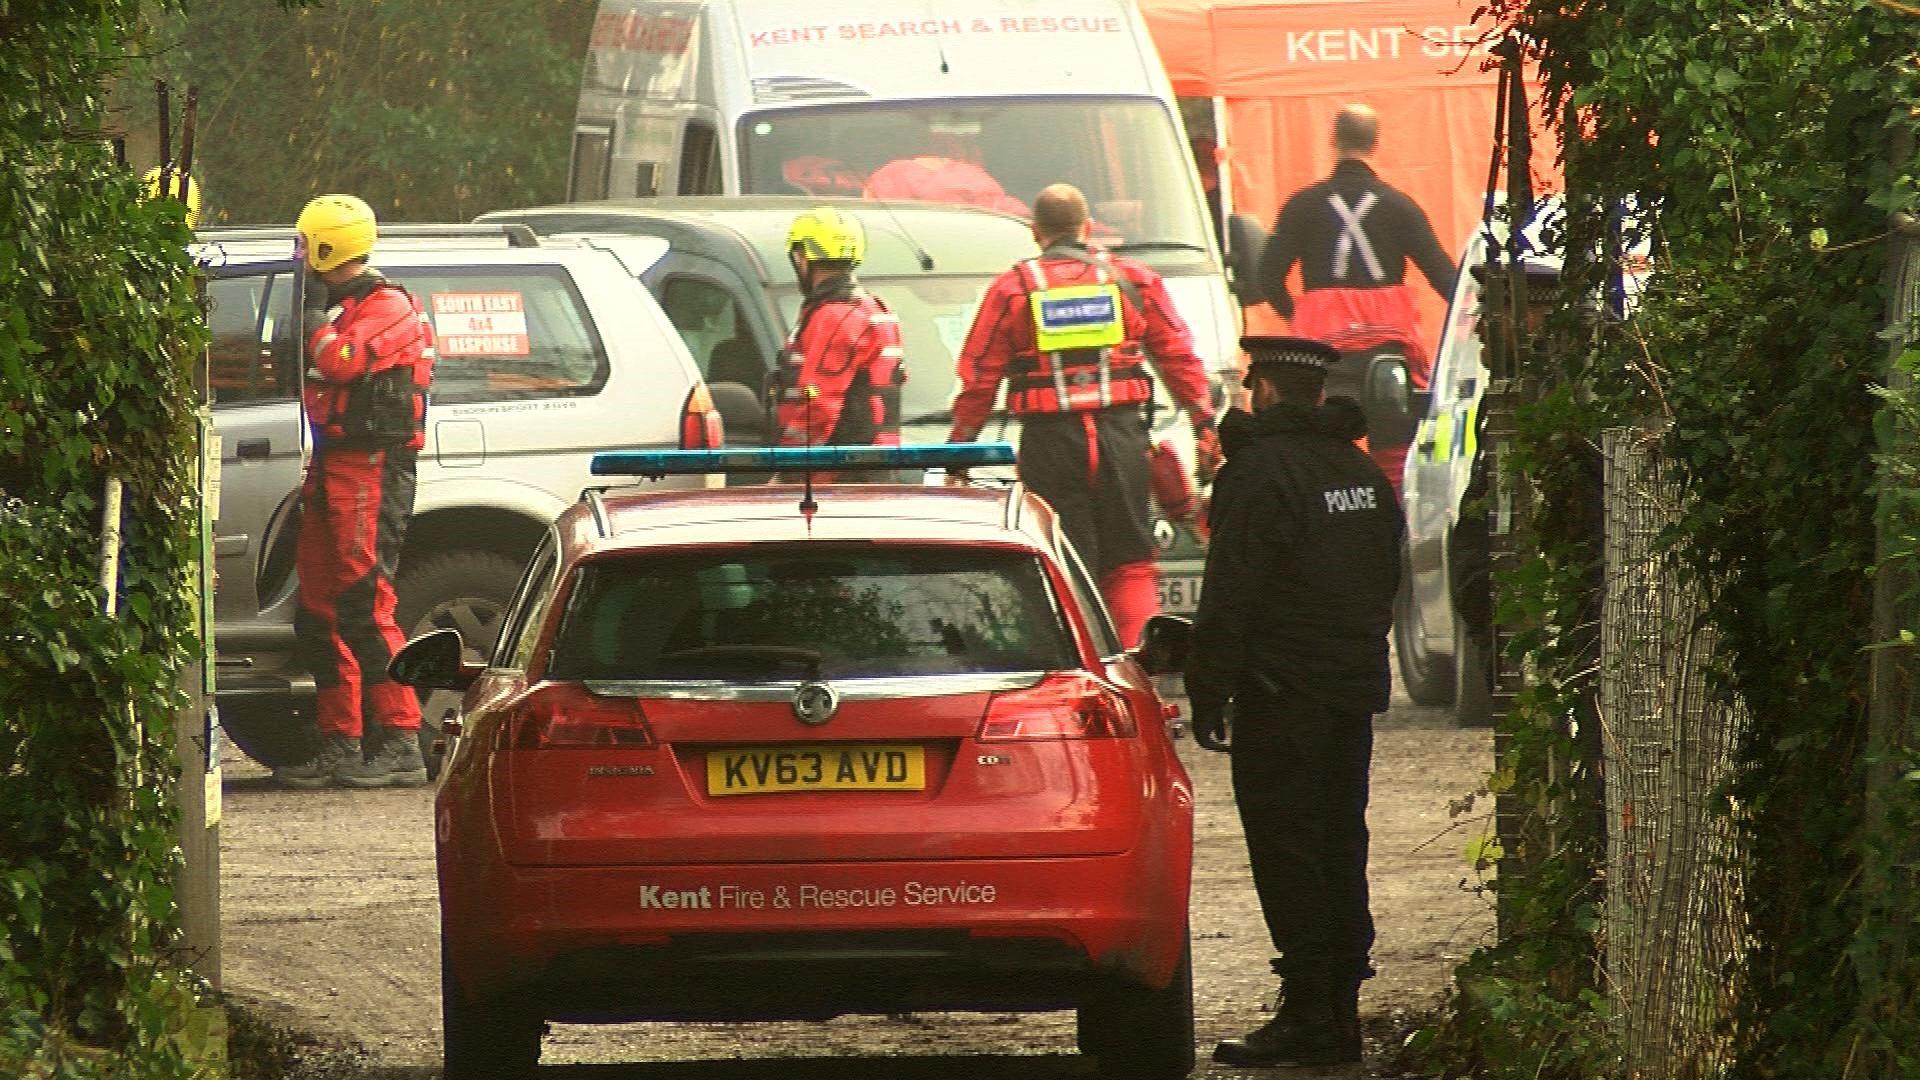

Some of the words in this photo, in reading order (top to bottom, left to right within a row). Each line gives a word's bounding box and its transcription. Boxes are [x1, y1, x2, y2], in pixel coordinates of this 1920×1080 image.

[750, 25, 829, 48] KENT
[837, 20, 962, 42] SEARCH
[971, 17, 993, 34] &
[1000, 16, 1122, 34] RESCUE
[1286, 26, 1405, 62] KENT
[448, 335, 519, 353] RESPONSE
[1323, 487, 1377, 513] POLICE
[725, 753, 824, 788] KV63
[836, 751, 909, 784] AVD
[639, 885, 711, 909] Kent
[718, 885, 765, 909] Fire
[772, 885, 792, 909] &
[799, 884, 896, 908] Rescue
[903, 880, 997, 905] Service
